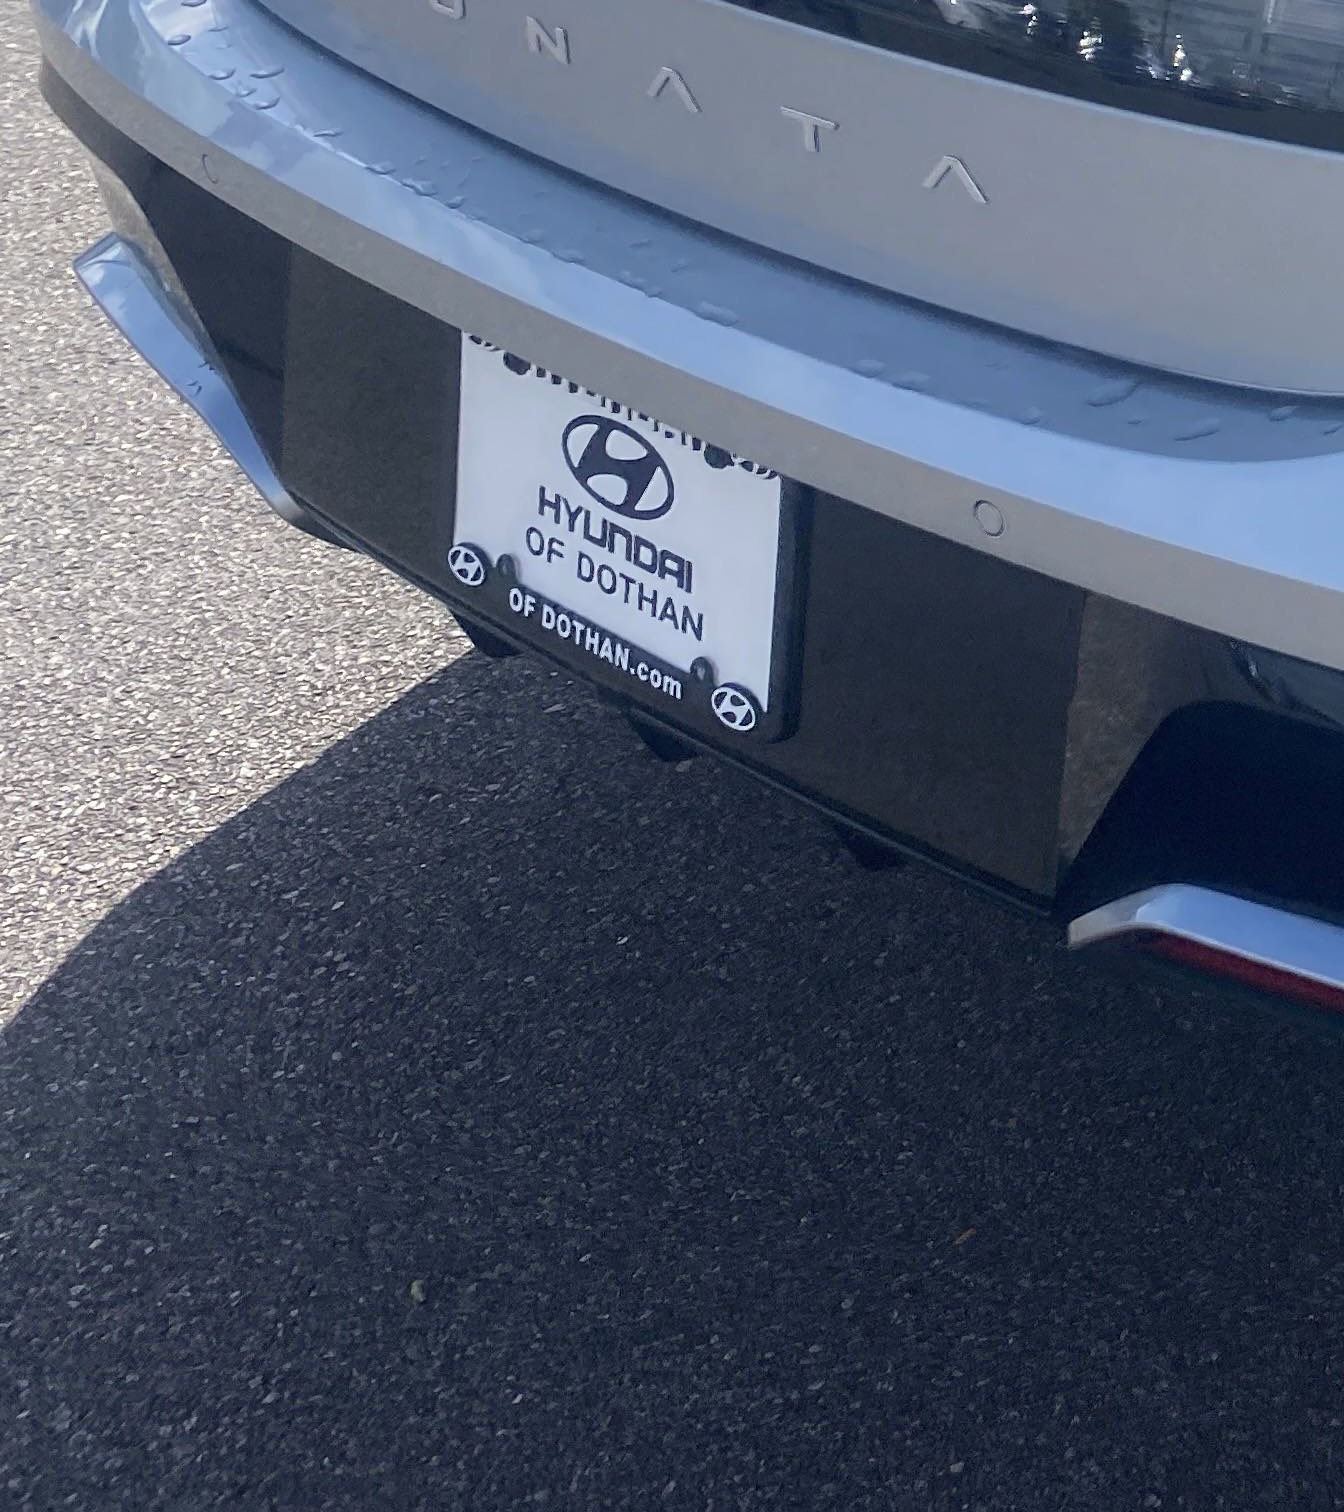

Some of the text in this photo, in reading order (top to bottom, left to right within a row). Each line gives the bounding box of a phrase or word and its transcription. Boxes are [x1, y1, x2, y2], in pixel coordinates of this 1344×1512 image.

[525, 526, 704, 642] OF DOTHAN
[538, 485, 693, 593] HYUNDAI
[508, 588, 683, 701] OF DOTHAN.com
